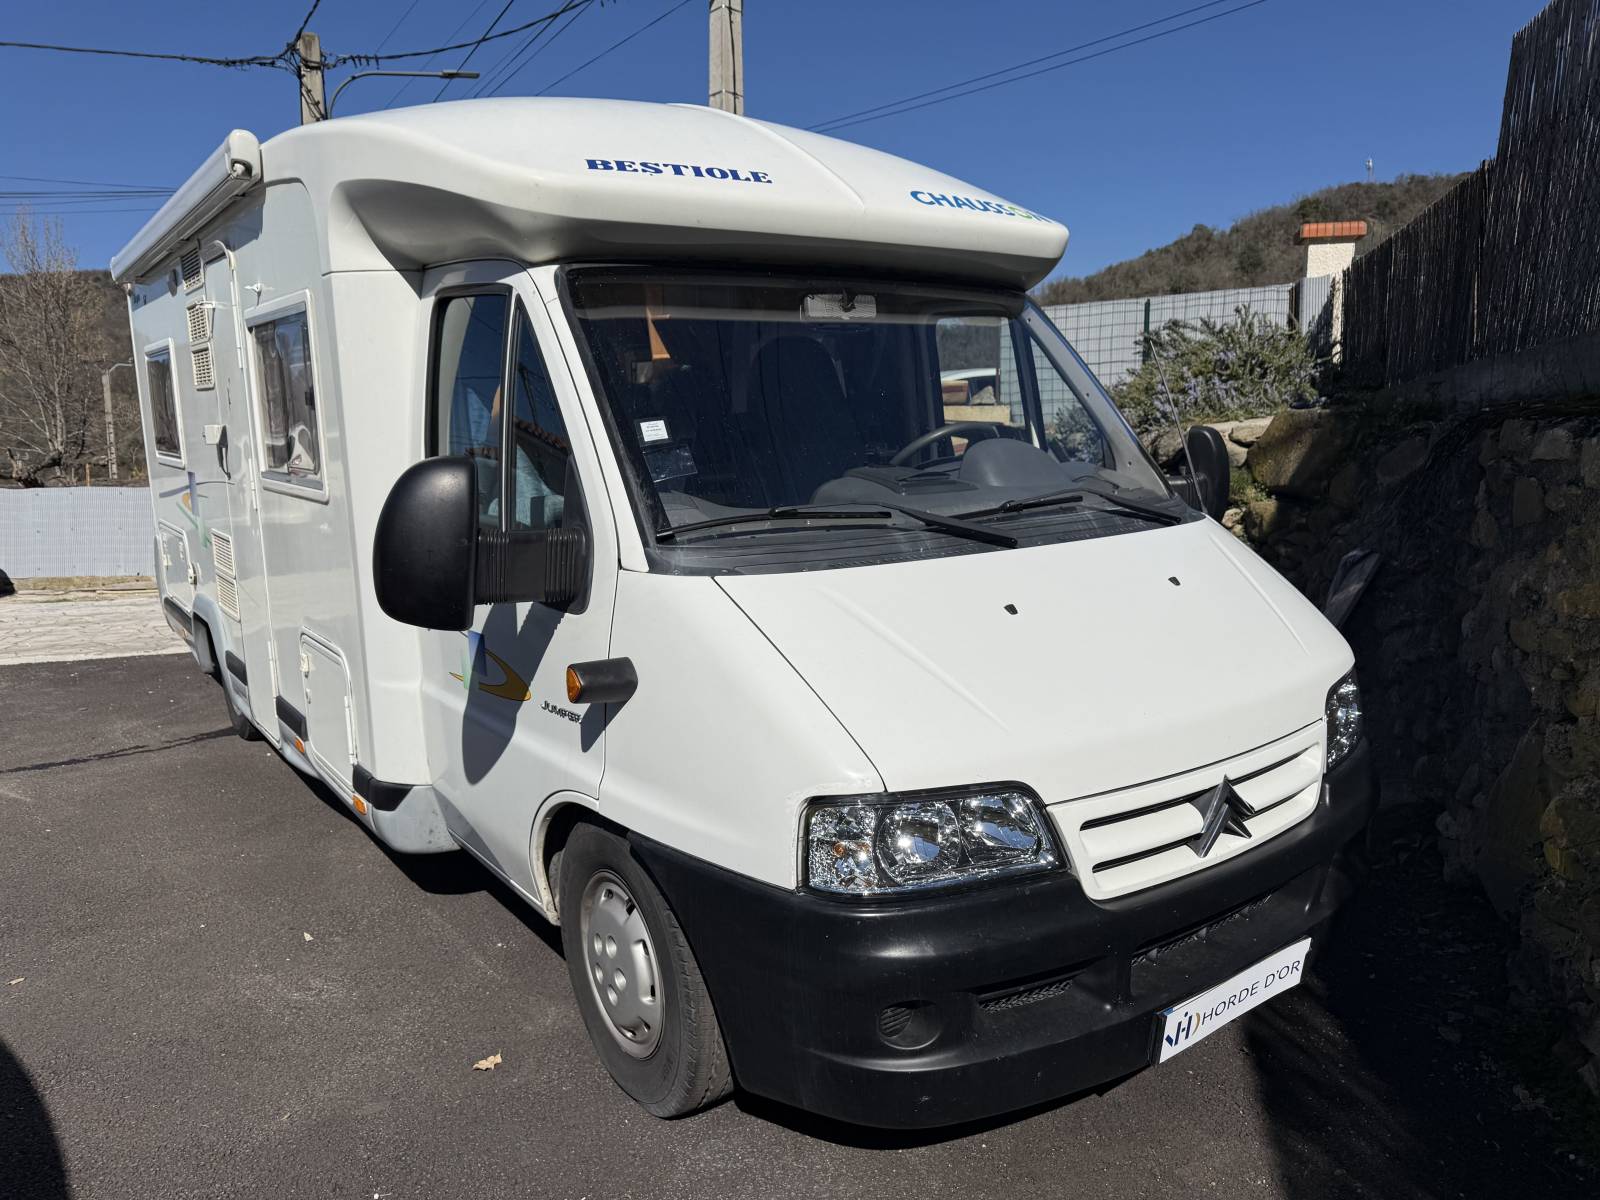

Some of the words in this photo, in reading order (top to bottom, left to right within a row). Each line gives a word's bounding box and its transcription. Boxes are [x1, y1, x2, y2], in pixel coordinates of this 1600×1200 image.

[584, 158, 773, 184] BESTIOLE
[1201, 980, 1260, 1026] HORDE
[1264, 960, 1301, 989] D'OR
